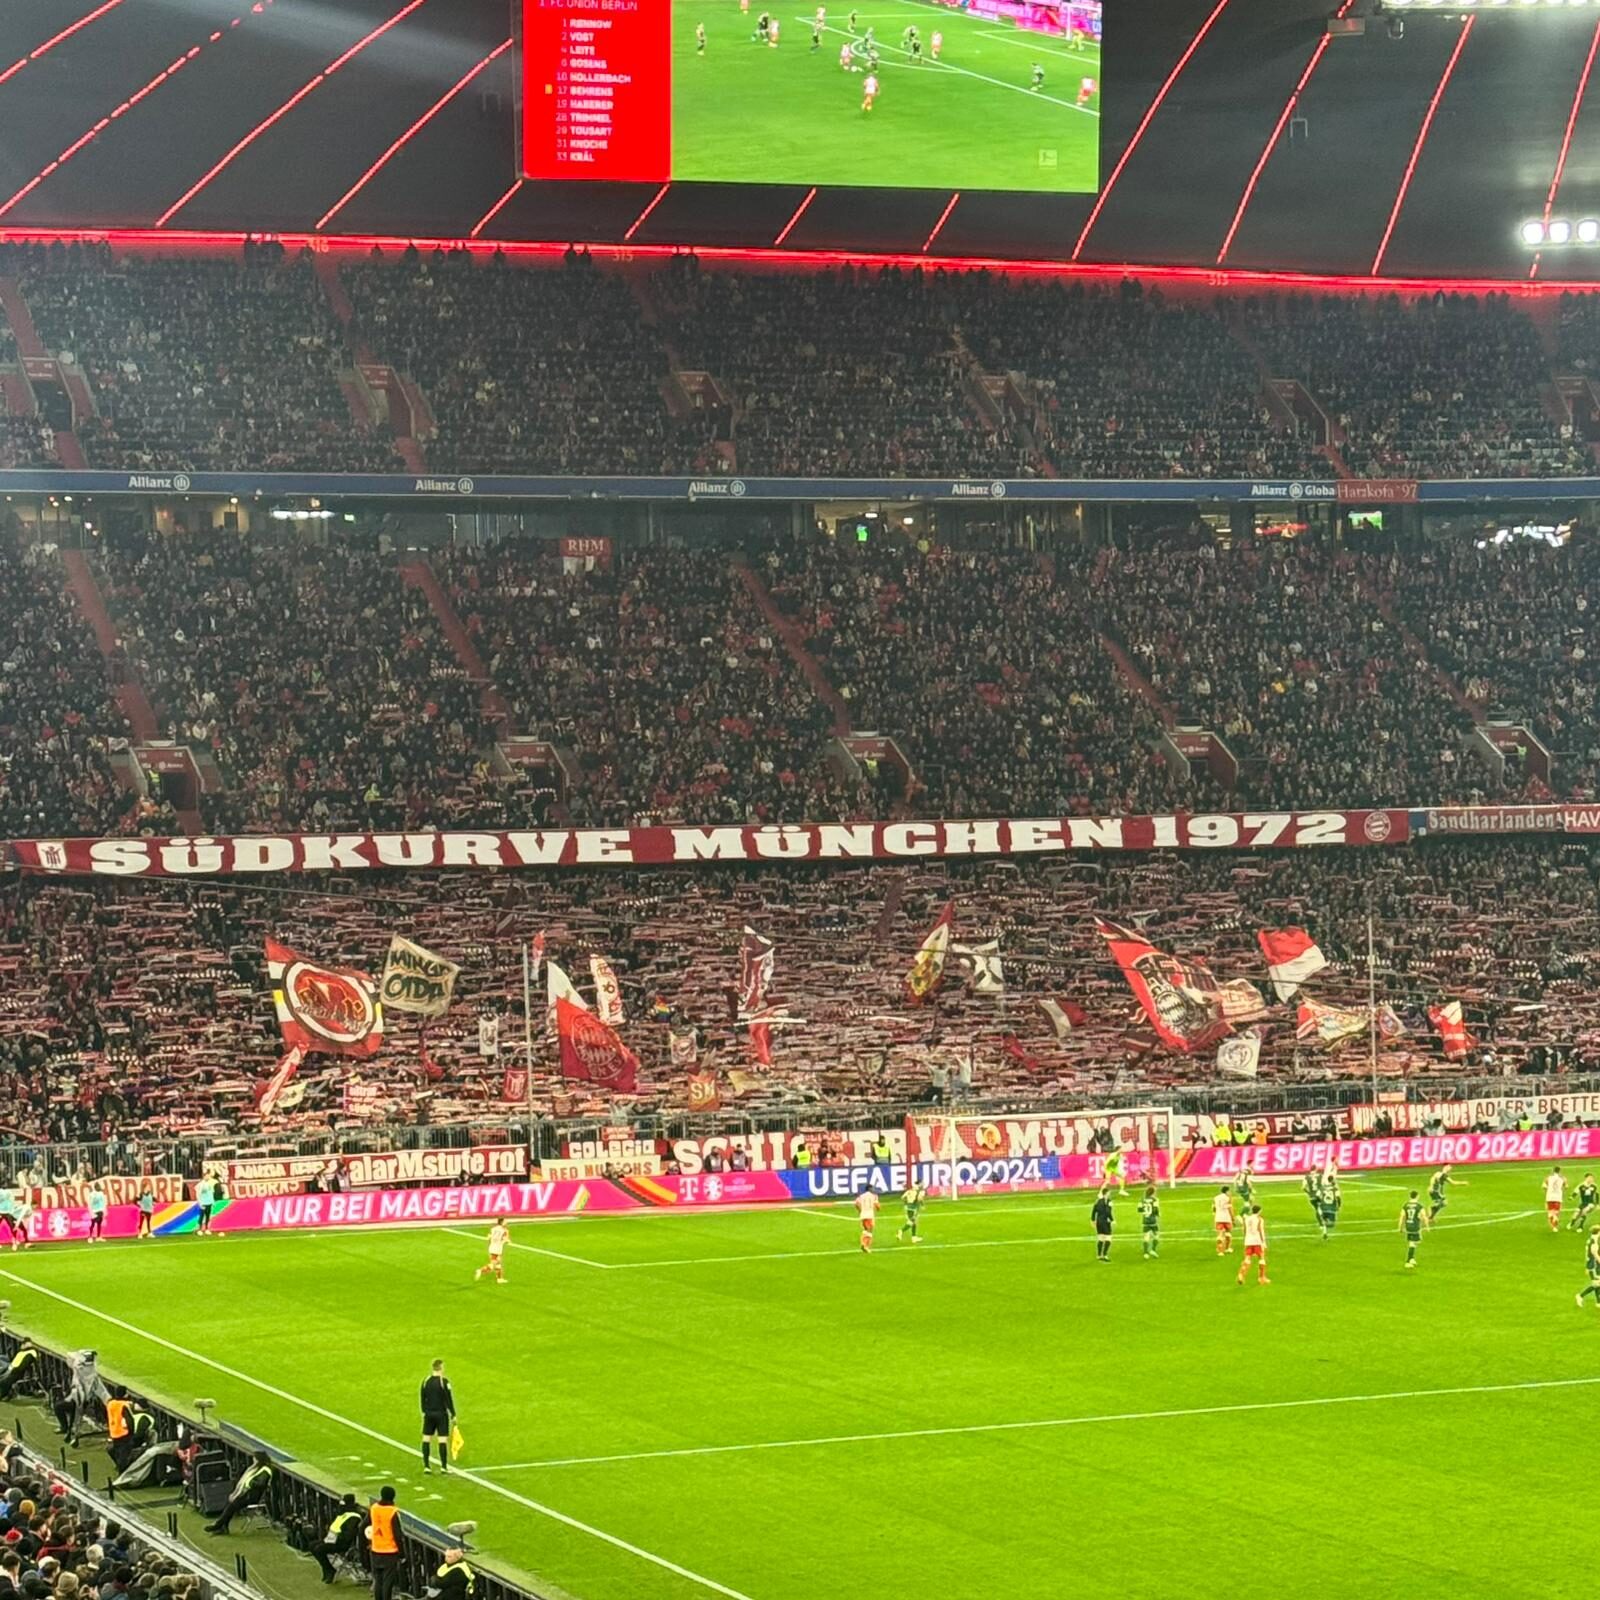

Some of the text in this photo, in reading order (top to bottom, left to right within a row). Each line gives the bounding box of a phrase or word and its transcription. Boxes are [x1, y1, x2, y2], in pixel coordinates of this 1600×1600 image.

[601, 0, 638, 11] BERLIN
[570, 45, 596, 55] LEITE
[570, 72, 631, 83] HOLLERBACH
[570, 126, 612, 136] TOUSART
[128, 475, 172, 488] Allianz
[415, 479, 457, 491] Allianz
[689, 481, 728, 494] Allianz
[951, 483, 989, 495] Allianz
[1251, 484, 1288, 496] Allianz
[90, 812, 1347, 875] SÜDKURVE MÜNCHEN 1972
[1210, 1130, 1590, 1173] ALLE SPIELE DER EURO 2024 LIVE
[488, 1147, 526, 1174] rot
[550, 1166, 578, 1181] RED
[234, 1181, 300, 1199] COBRAS
[261, 1183, 556, 1225] NUR BEI MAGENTA TV
